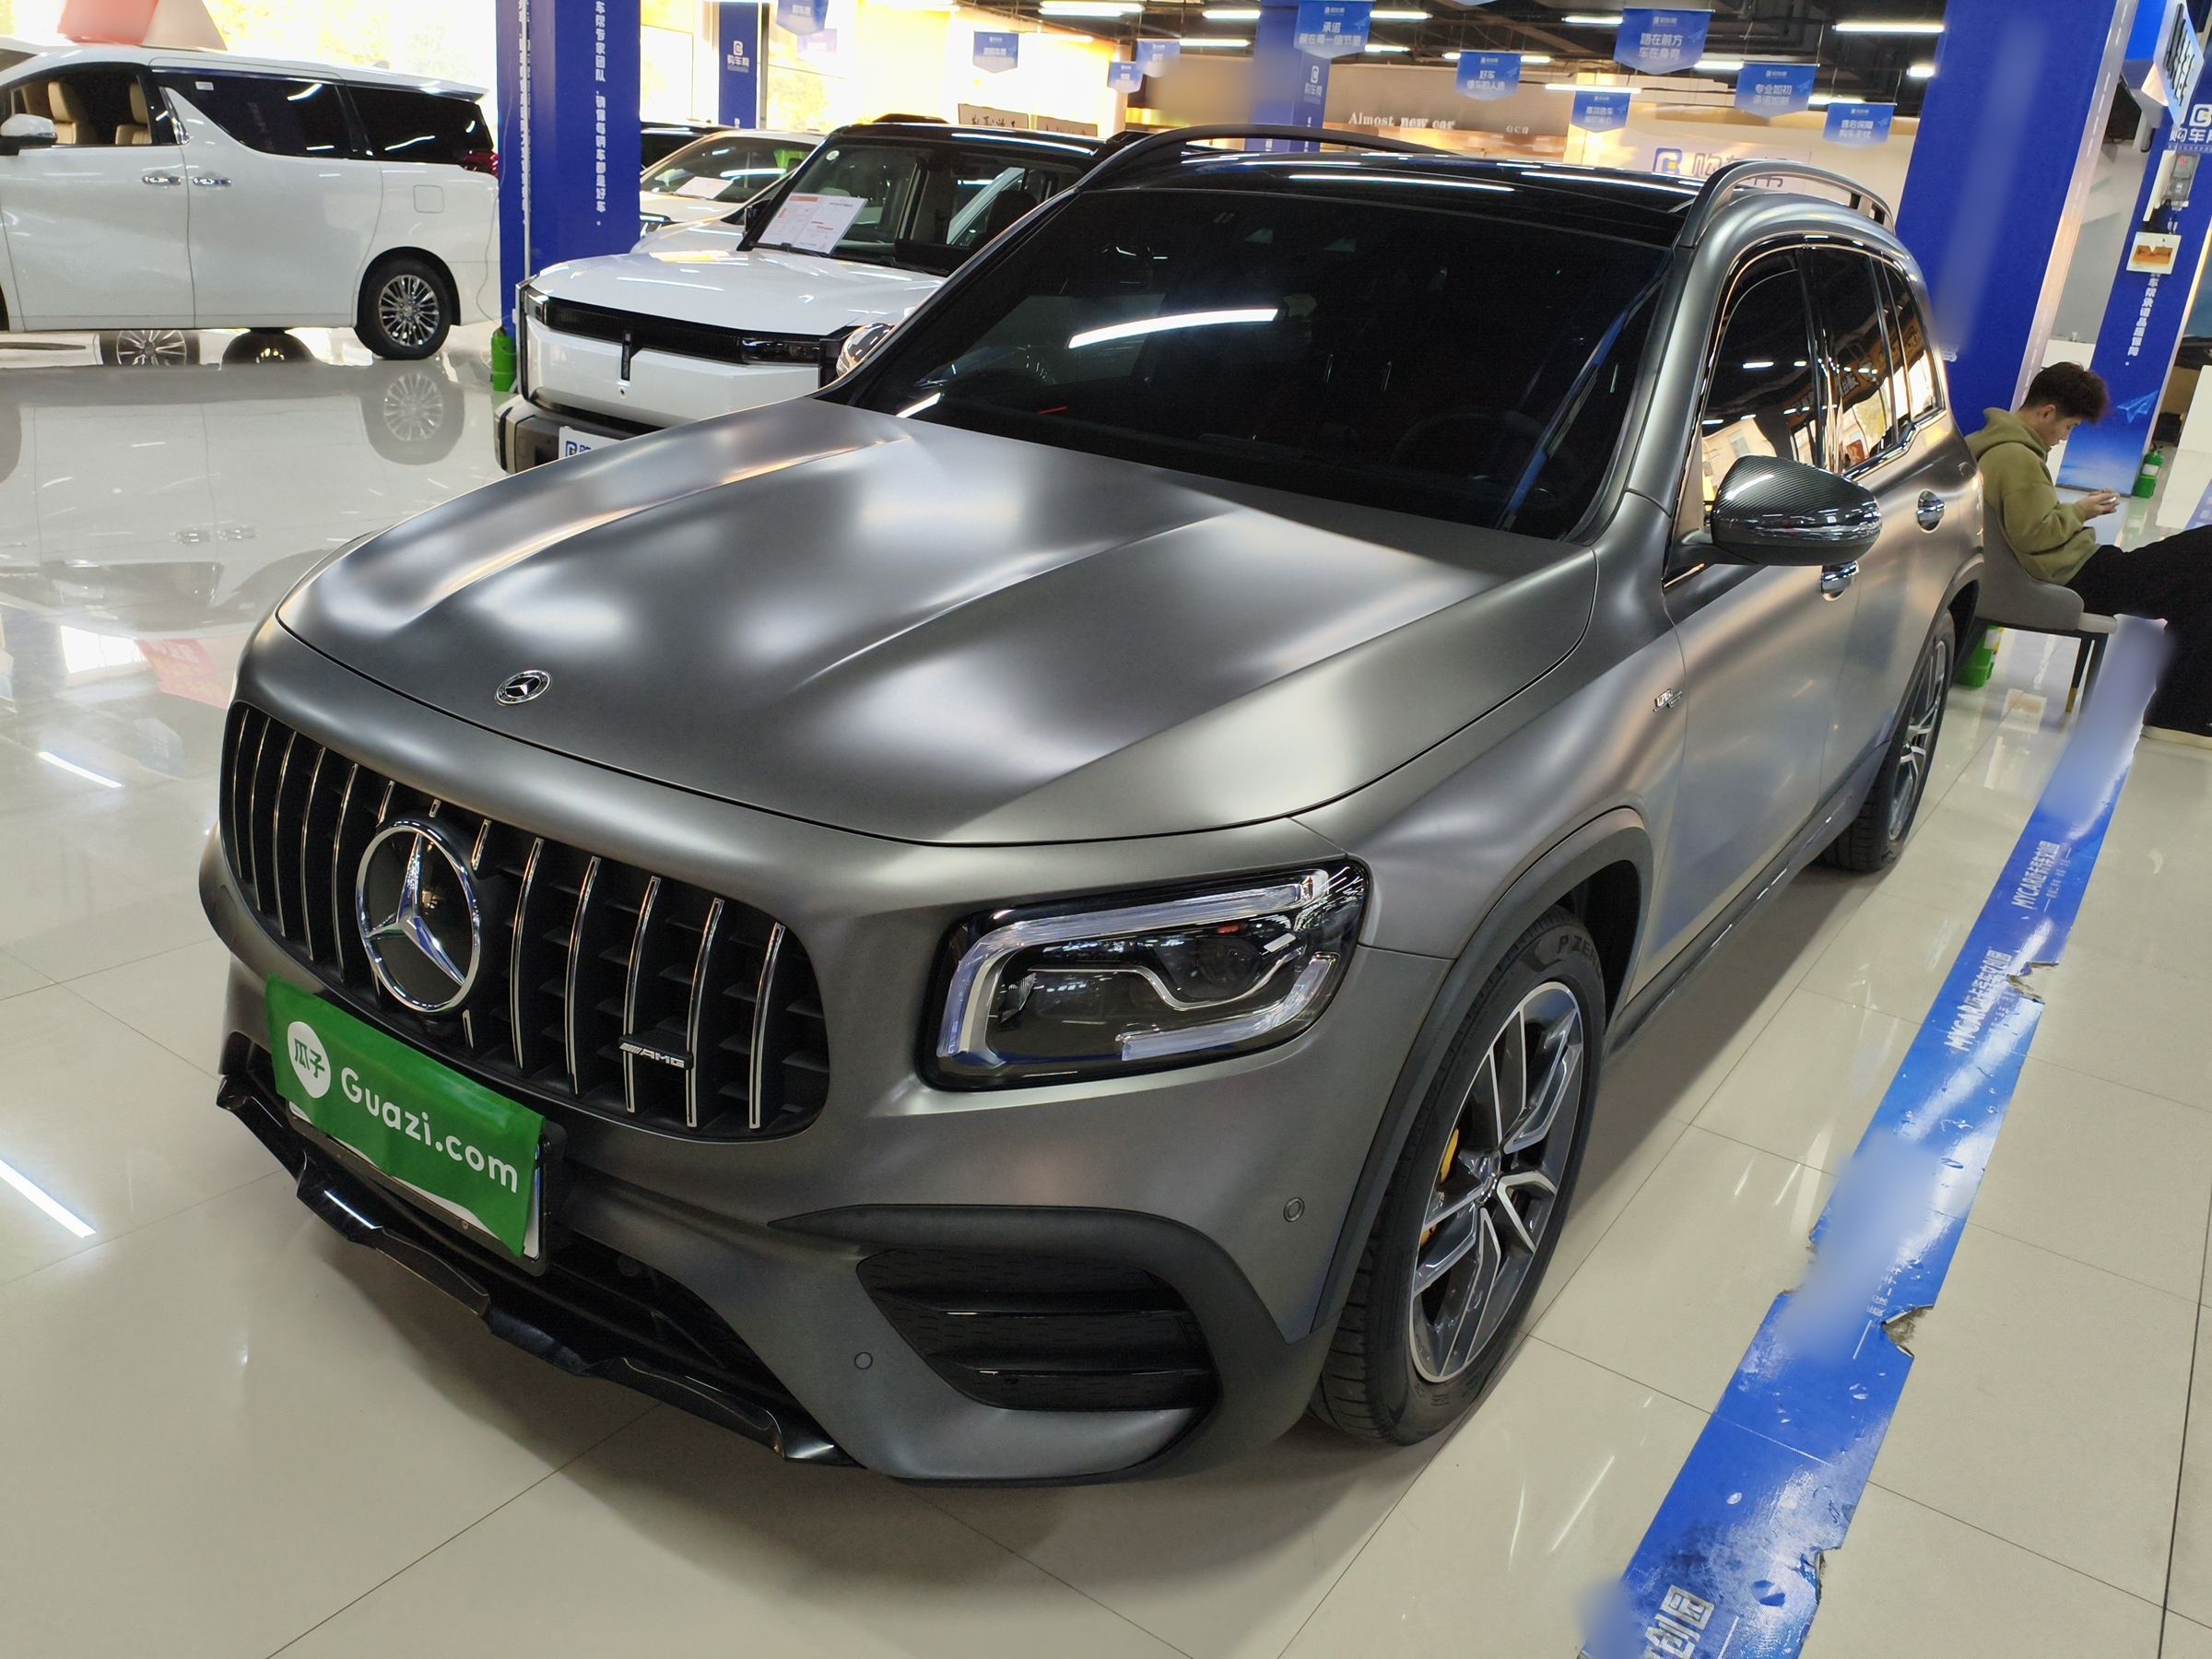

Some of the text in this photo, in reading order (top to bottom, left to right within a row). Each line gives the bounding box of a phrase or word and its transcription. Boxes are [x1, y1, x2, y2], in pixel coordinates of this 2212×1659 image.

[1348, 112, 1455, 129] Almost new car
[2170, 128, 2212, 144] 购车
[294, 1038, 324, 1078] 瓜子
[639, 1048, 685, 1068] AMG
[341, 1067, 518, 1194] Guazi.com
[1643, 1584, 1714, 1659] 创园
